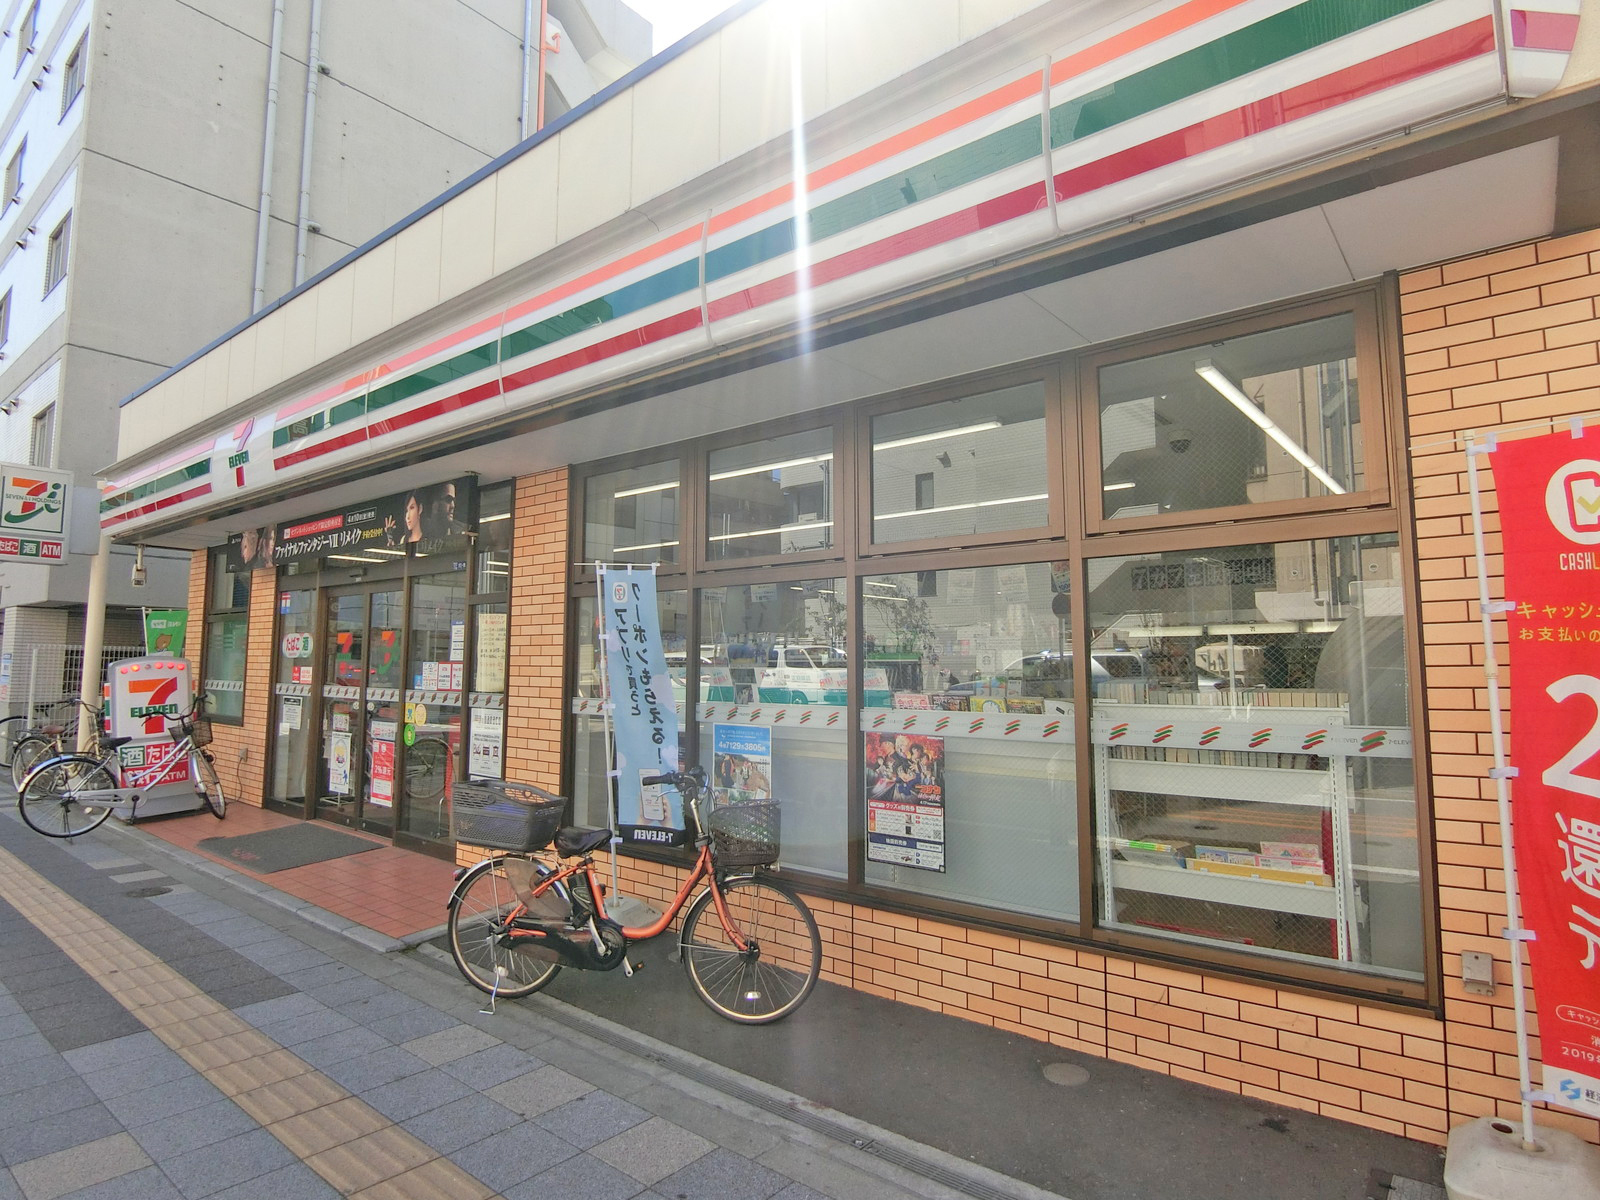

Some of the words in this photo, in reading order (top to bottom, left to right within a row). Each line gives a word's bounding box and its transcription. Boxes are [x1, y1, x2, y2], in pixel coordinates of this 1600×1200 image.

[23, 542, 38, 554] 酒
[42, 544, 62, 556] ATM
[121, 747, 144, 767] 酒
